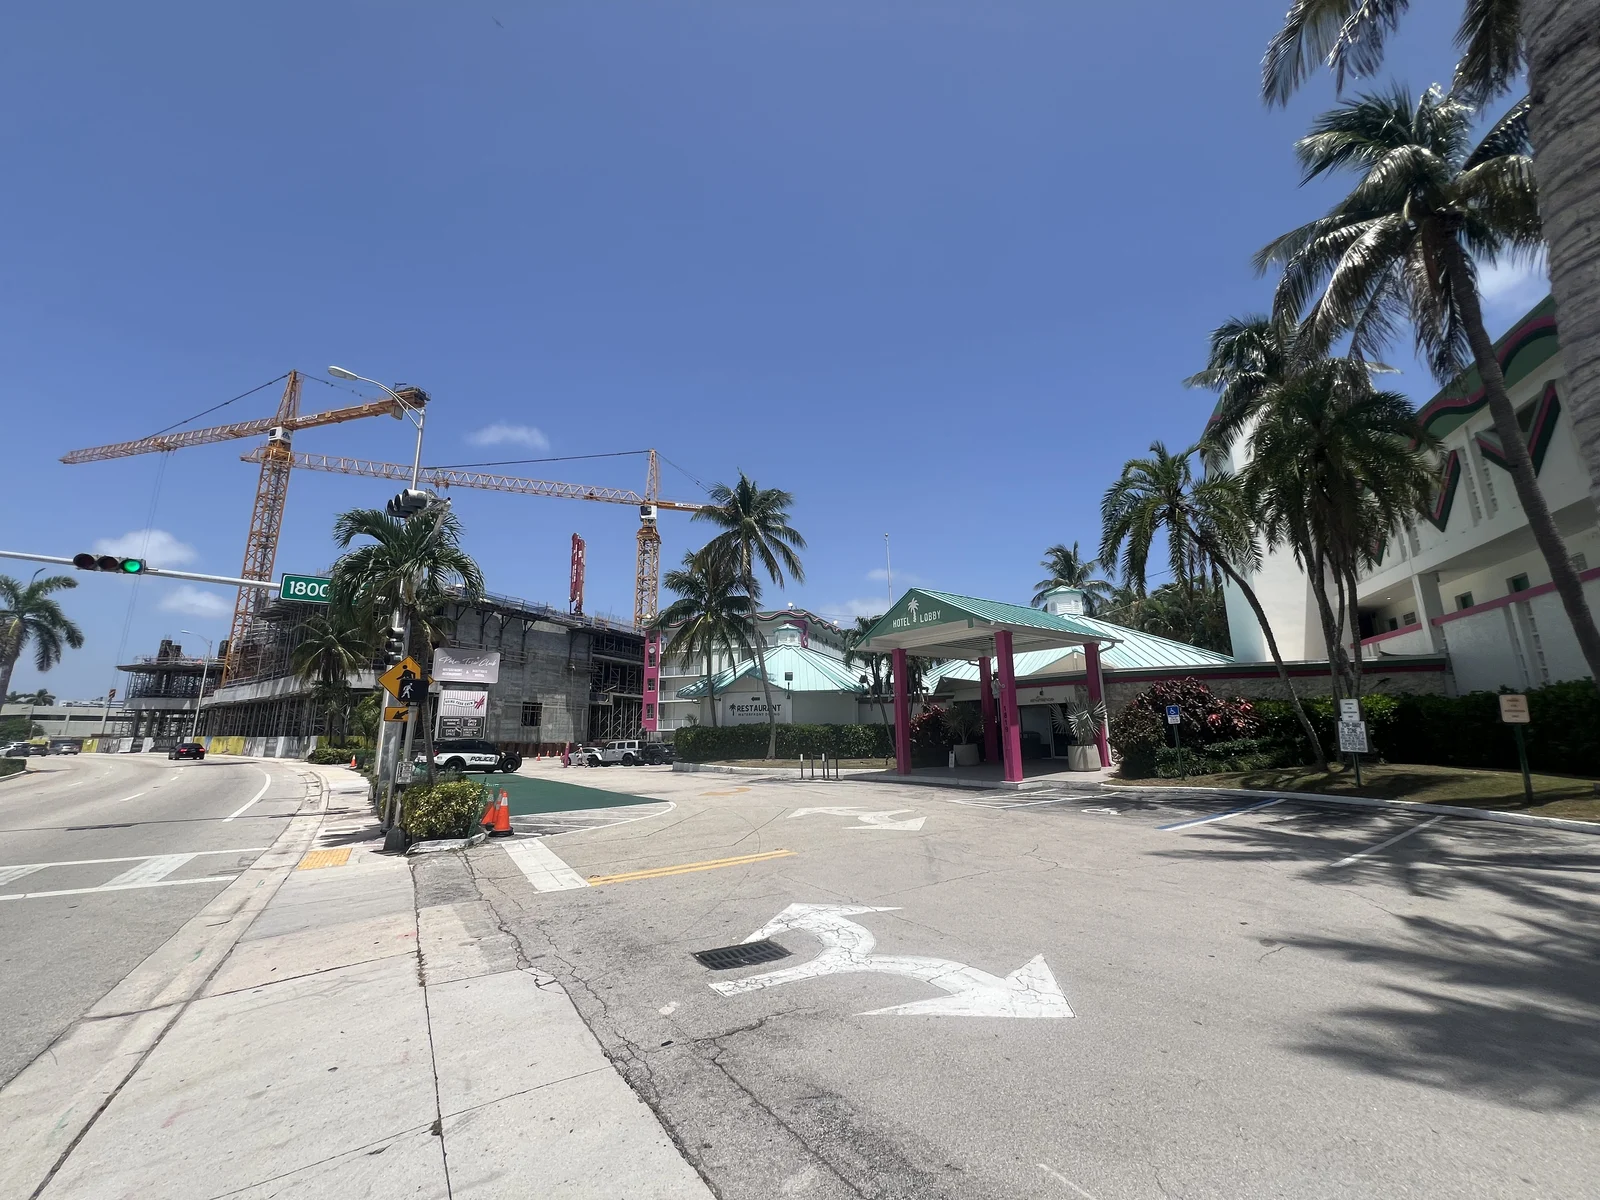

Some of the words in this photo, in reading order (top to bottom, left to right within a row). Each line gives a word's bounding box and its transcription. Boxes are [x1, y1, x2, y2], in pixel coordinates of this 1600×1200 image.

[290, 581, 330, 597] 1800
[893, 617, 910, 628] HOTEL
[920, 610, 941, 623] LOBBY
